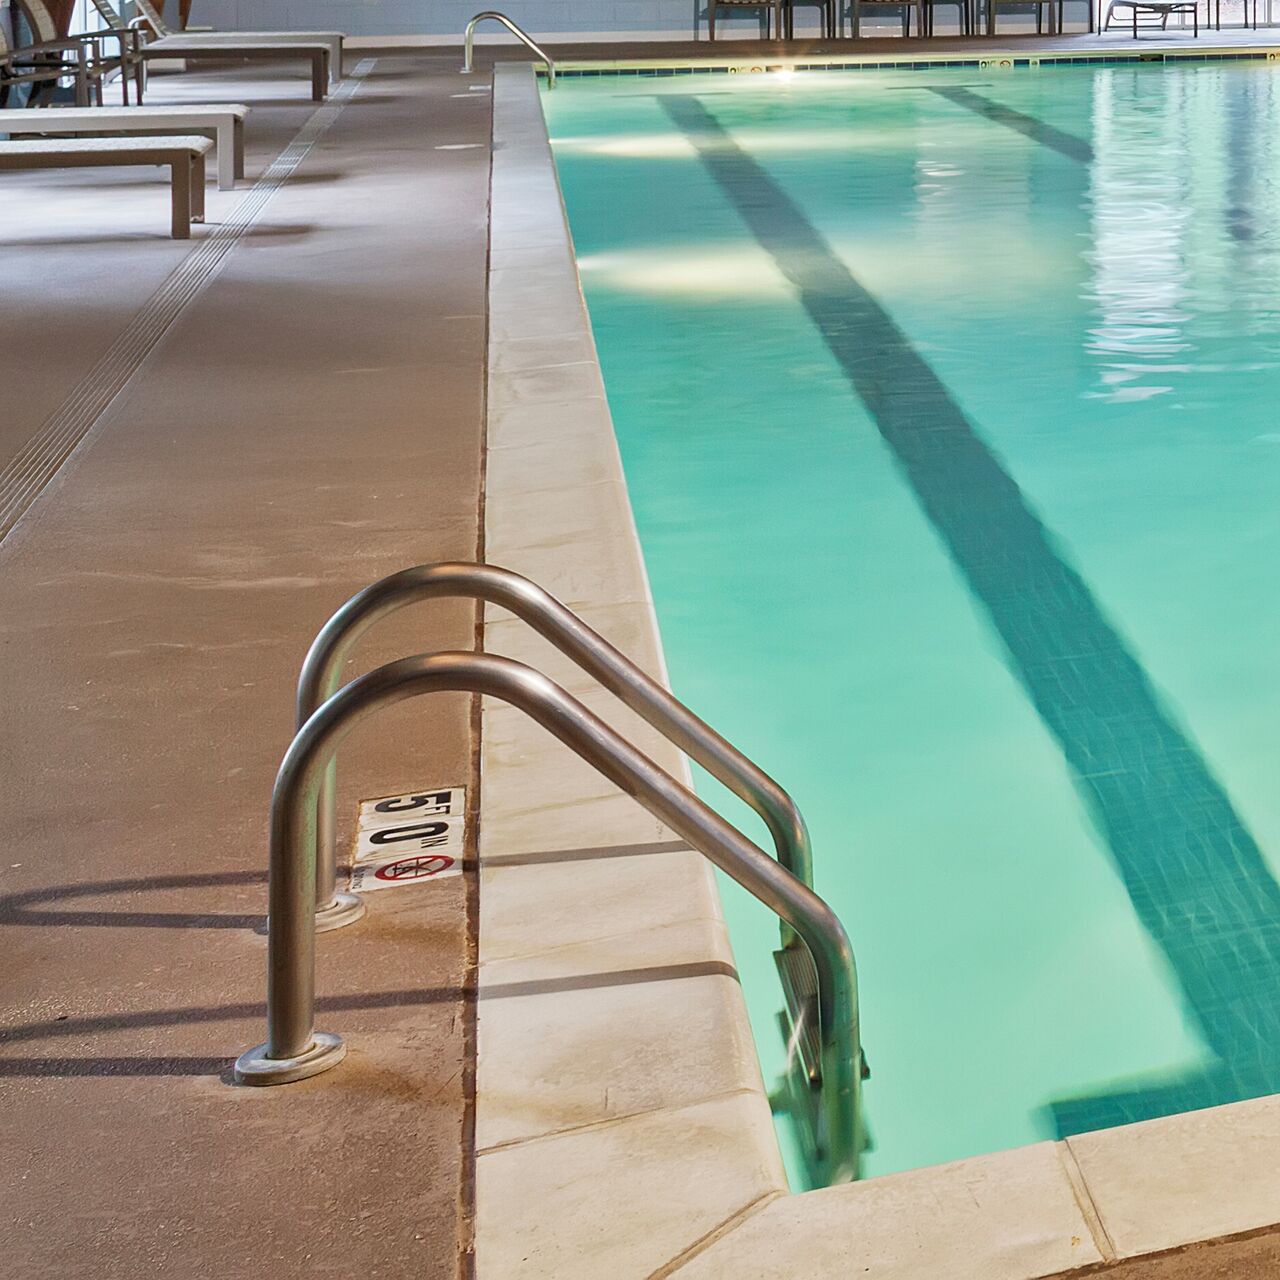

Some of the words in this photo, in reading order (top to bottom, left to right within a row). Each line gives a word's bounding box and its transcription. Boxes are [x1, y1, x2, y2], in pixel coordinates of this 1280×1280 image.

[374, 791, 452, 813] 5
[424, 804, 451, 817] FT
[369, 821, 450, 845] 0
[420, 834, 449, 849] IN
